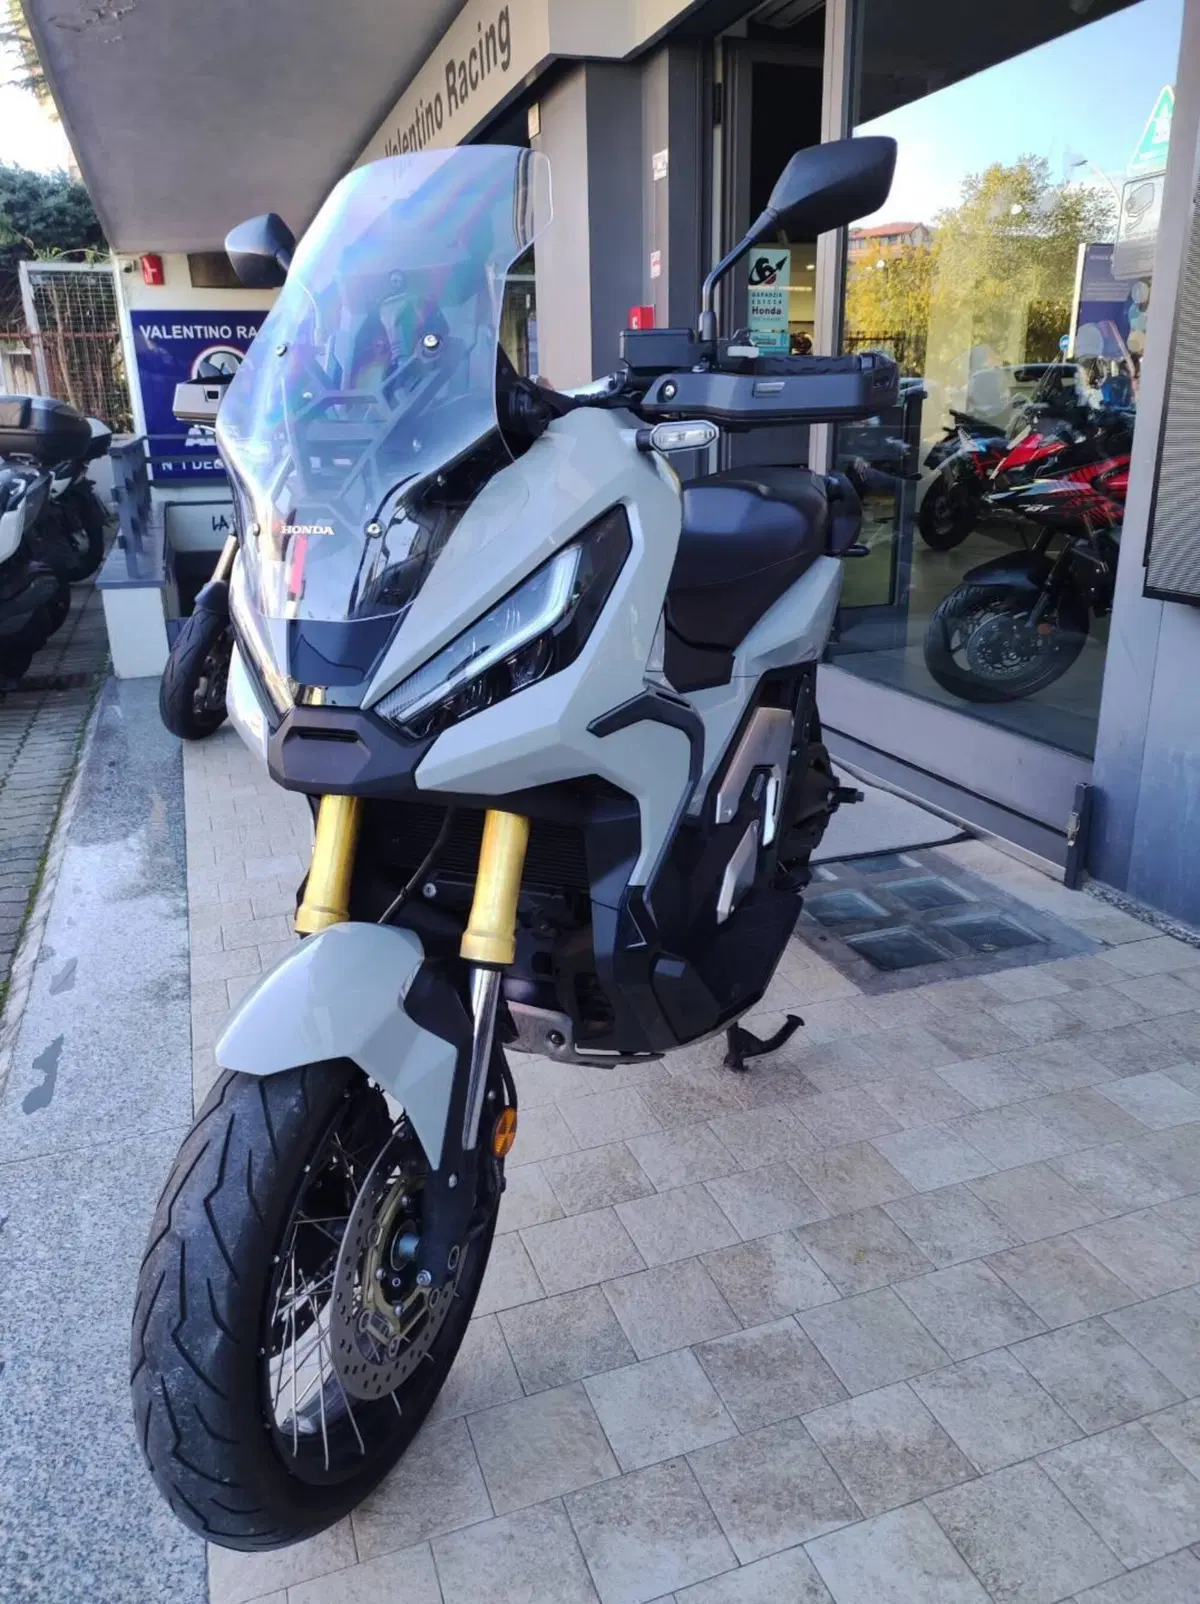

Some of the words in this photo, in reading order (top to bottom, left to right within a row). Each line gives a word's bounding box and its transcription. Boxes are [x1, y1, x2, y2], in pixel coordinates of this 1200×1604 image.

[445, 5, 511, 117] Racing
[752, 306, 782, 315] Honda
[140, 325, 232, 339] VALENTINO
[281, 525, 334, 535] HONDA
